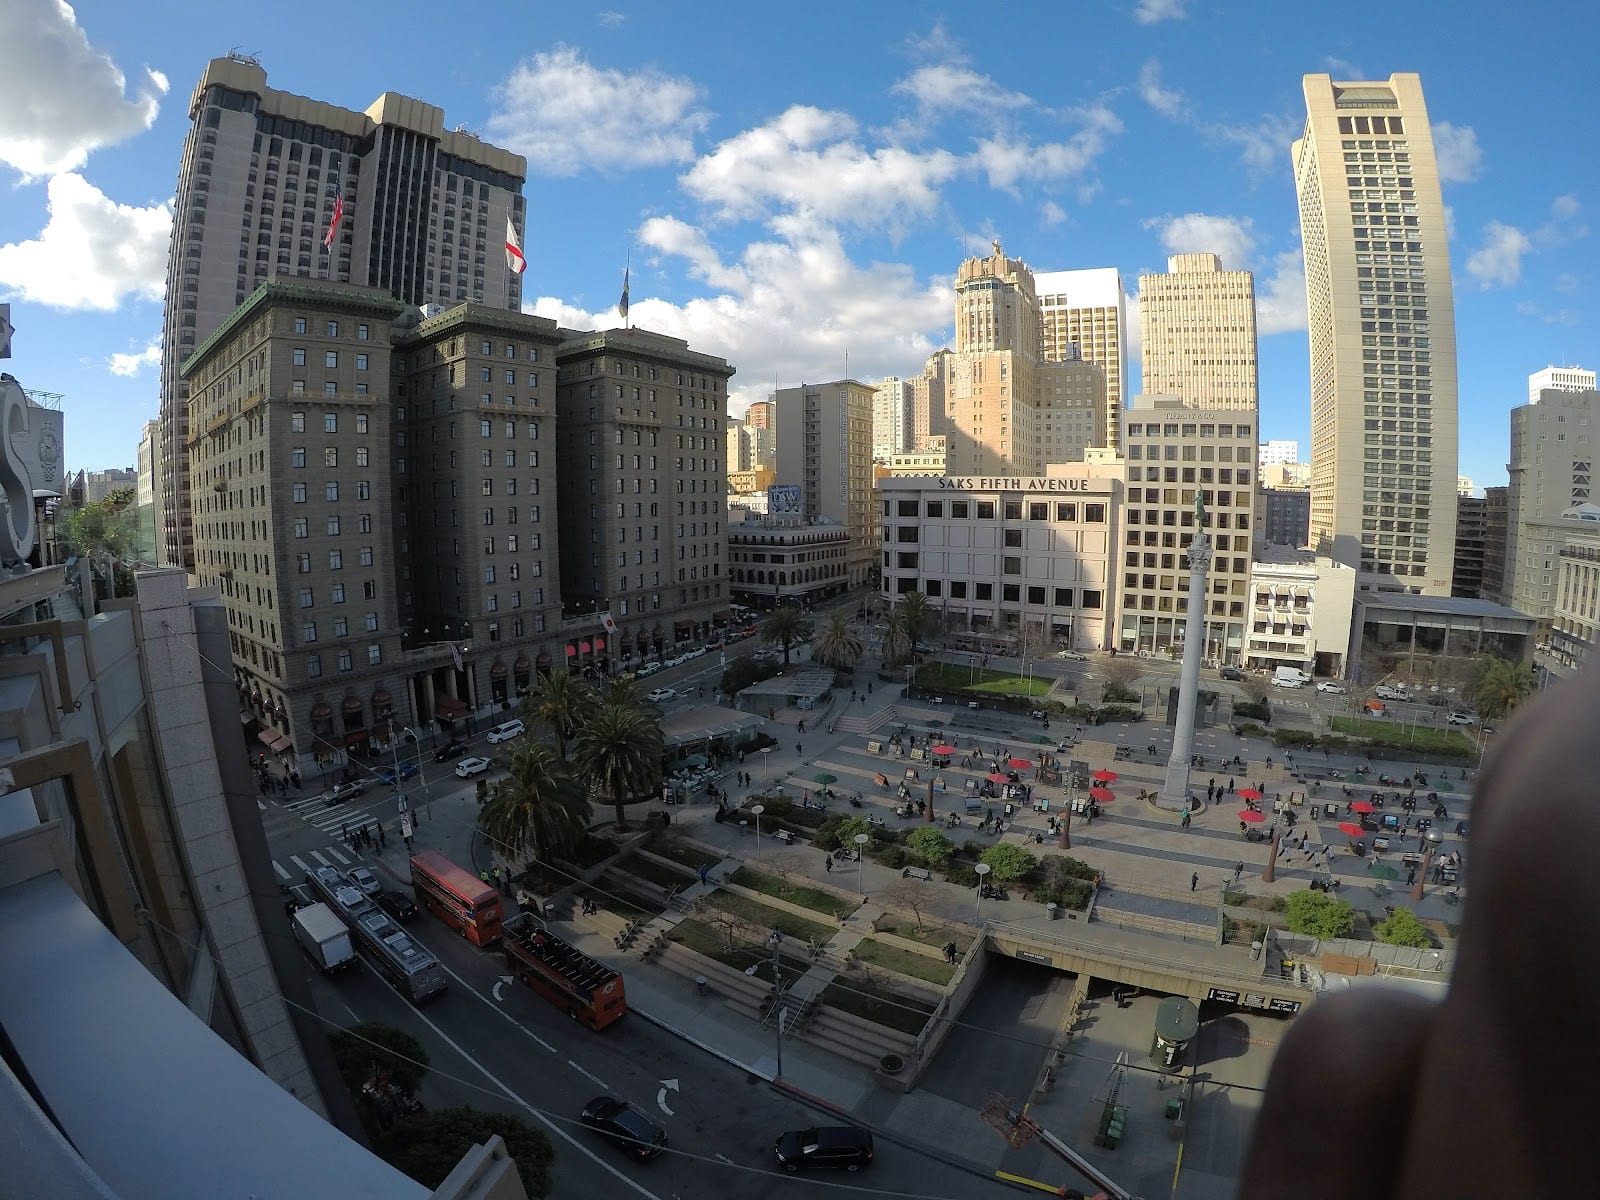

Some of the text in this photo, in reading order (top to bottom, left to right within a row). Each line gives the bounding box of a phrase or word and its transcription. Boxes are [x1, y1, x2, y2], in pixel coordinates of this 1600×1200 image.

[938, 478, 1089, 491] SAKS FIFTH AVENUE
[772, 492, 797, 502] DSW
